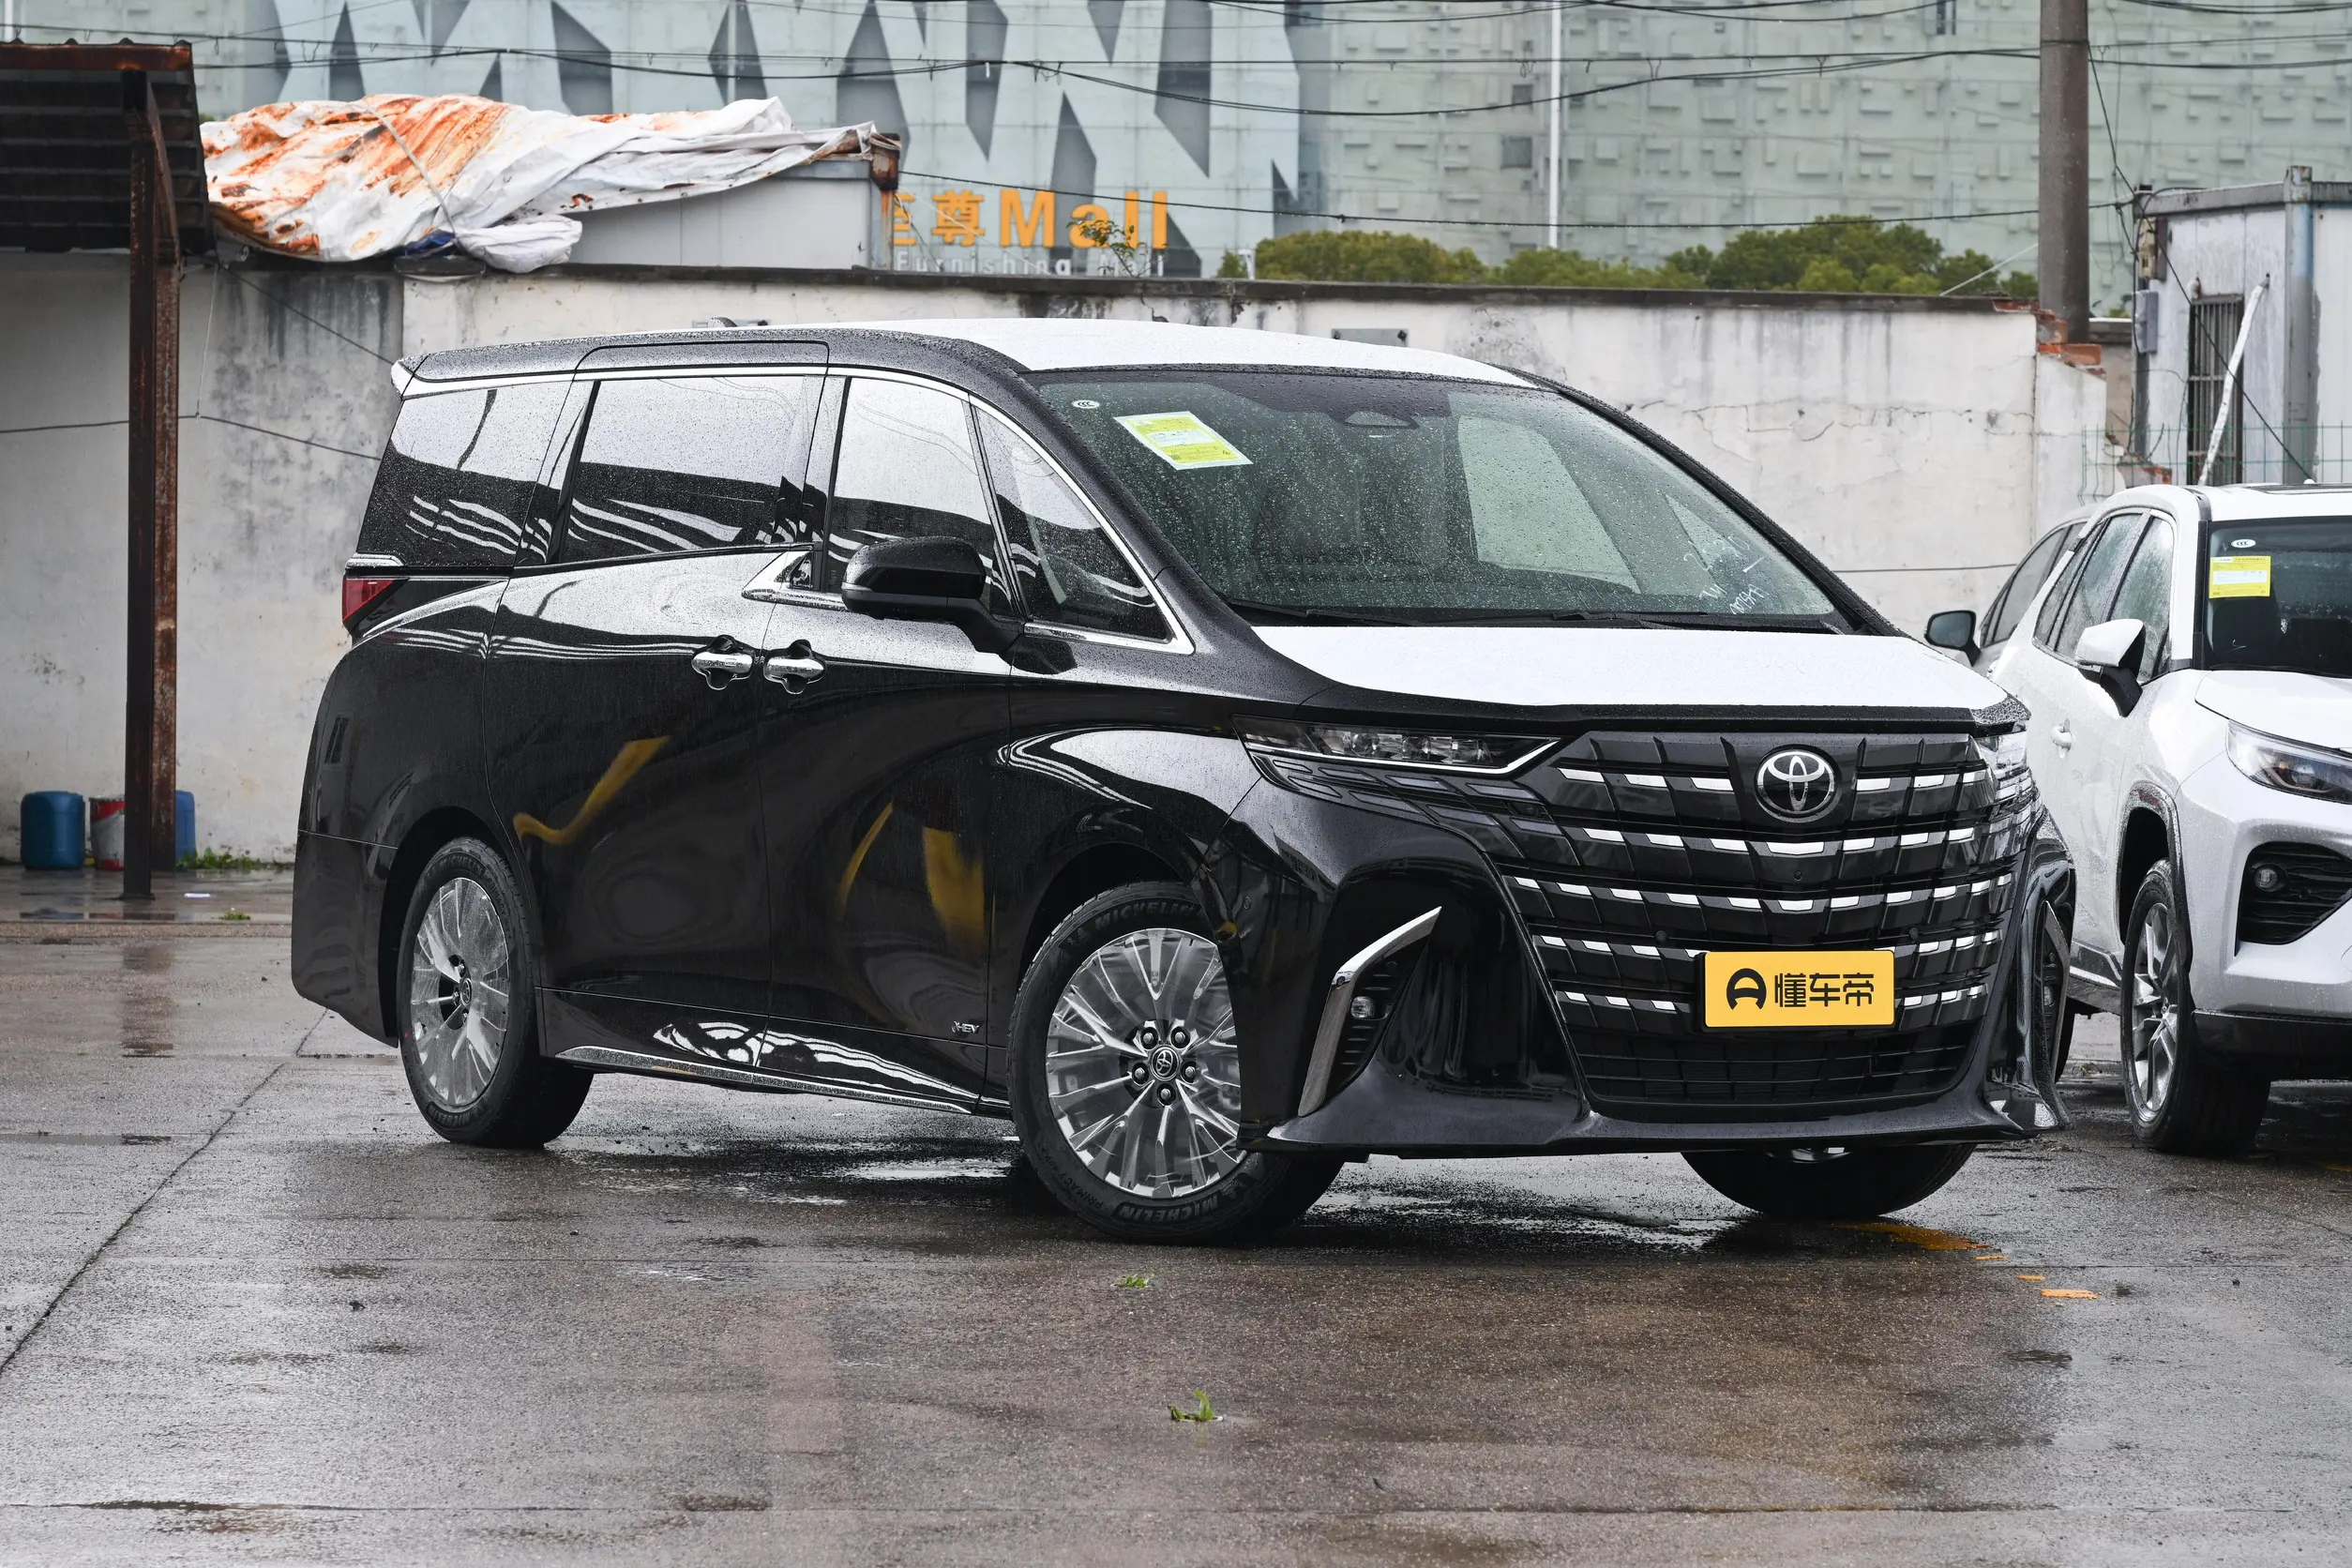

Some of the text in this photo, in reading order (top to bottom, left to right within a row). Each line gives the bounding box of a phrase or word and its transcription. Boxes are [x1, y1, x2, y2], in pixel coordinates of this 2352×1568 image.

[896, 250, 1072, 276] Furnishing
[1774, 972, 1874, 1007] 懂车帝
[1060, 1171, 1105, 1210] PRIMACY
[1119, 1194, 1219, 1222] MICHELIN
